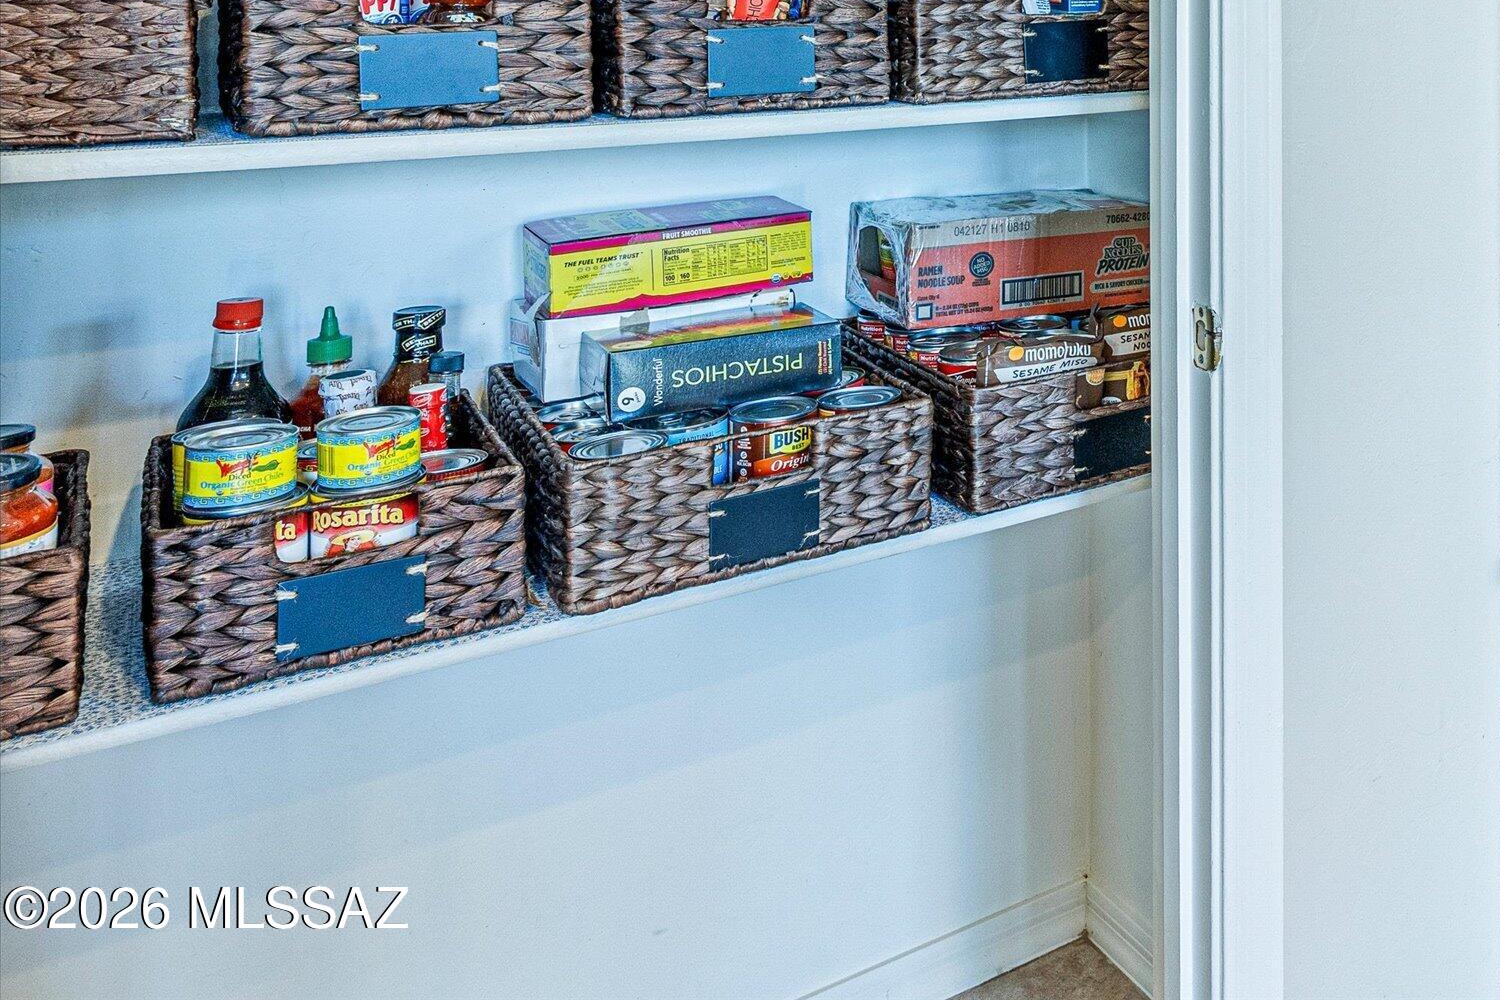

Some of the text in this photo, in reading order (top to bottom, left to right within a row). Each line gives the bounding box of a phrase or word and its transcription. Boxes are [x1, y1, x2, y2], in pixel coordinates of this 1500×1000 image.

[662, 227, 712, 240] FRUIT SMOOTHIE
[953, 223, 987, 237] 042127
[1007, 220, 1031, 232] 0810
[1114, 237, 1136, 248] CUP
[664, 247, 690, 256] Nutrition
[1104, 244, 1143, 259] NOODLES
[564, 252, 639, 268] THE FUEL TEAMS TRUST
[1097, 252, 1149, 275] PROTEIN
[680, 272, 690, 280] 160
[918, 265, 943, 277] RAMEN
[918, 277, 946, 289] NOODLE
[947, 275, 965, 286] SOUP
[1094, 282, 1105, 290] RICH
[1126, 278, 1144, 286] CHICKEN
[1120, 331, 1150, 344] SESAM
[671, 352, 803, 388] PISTACHIOS
[1012, 358, 1088, 379] SESAME MISO
[653, 356, 663, 406] Wonderful
[774, 427, 809, 450] BUSH
[347, 456, 405, 472] Organic Green
[376, 452, 396, 461] Diced
[771, 453, 809, 472] Origin
[200, 471, 284, 490] Organic Green Chiles
[228, 472, 252, 481] Diced
[312, 504, 405, 533] Rosarita
